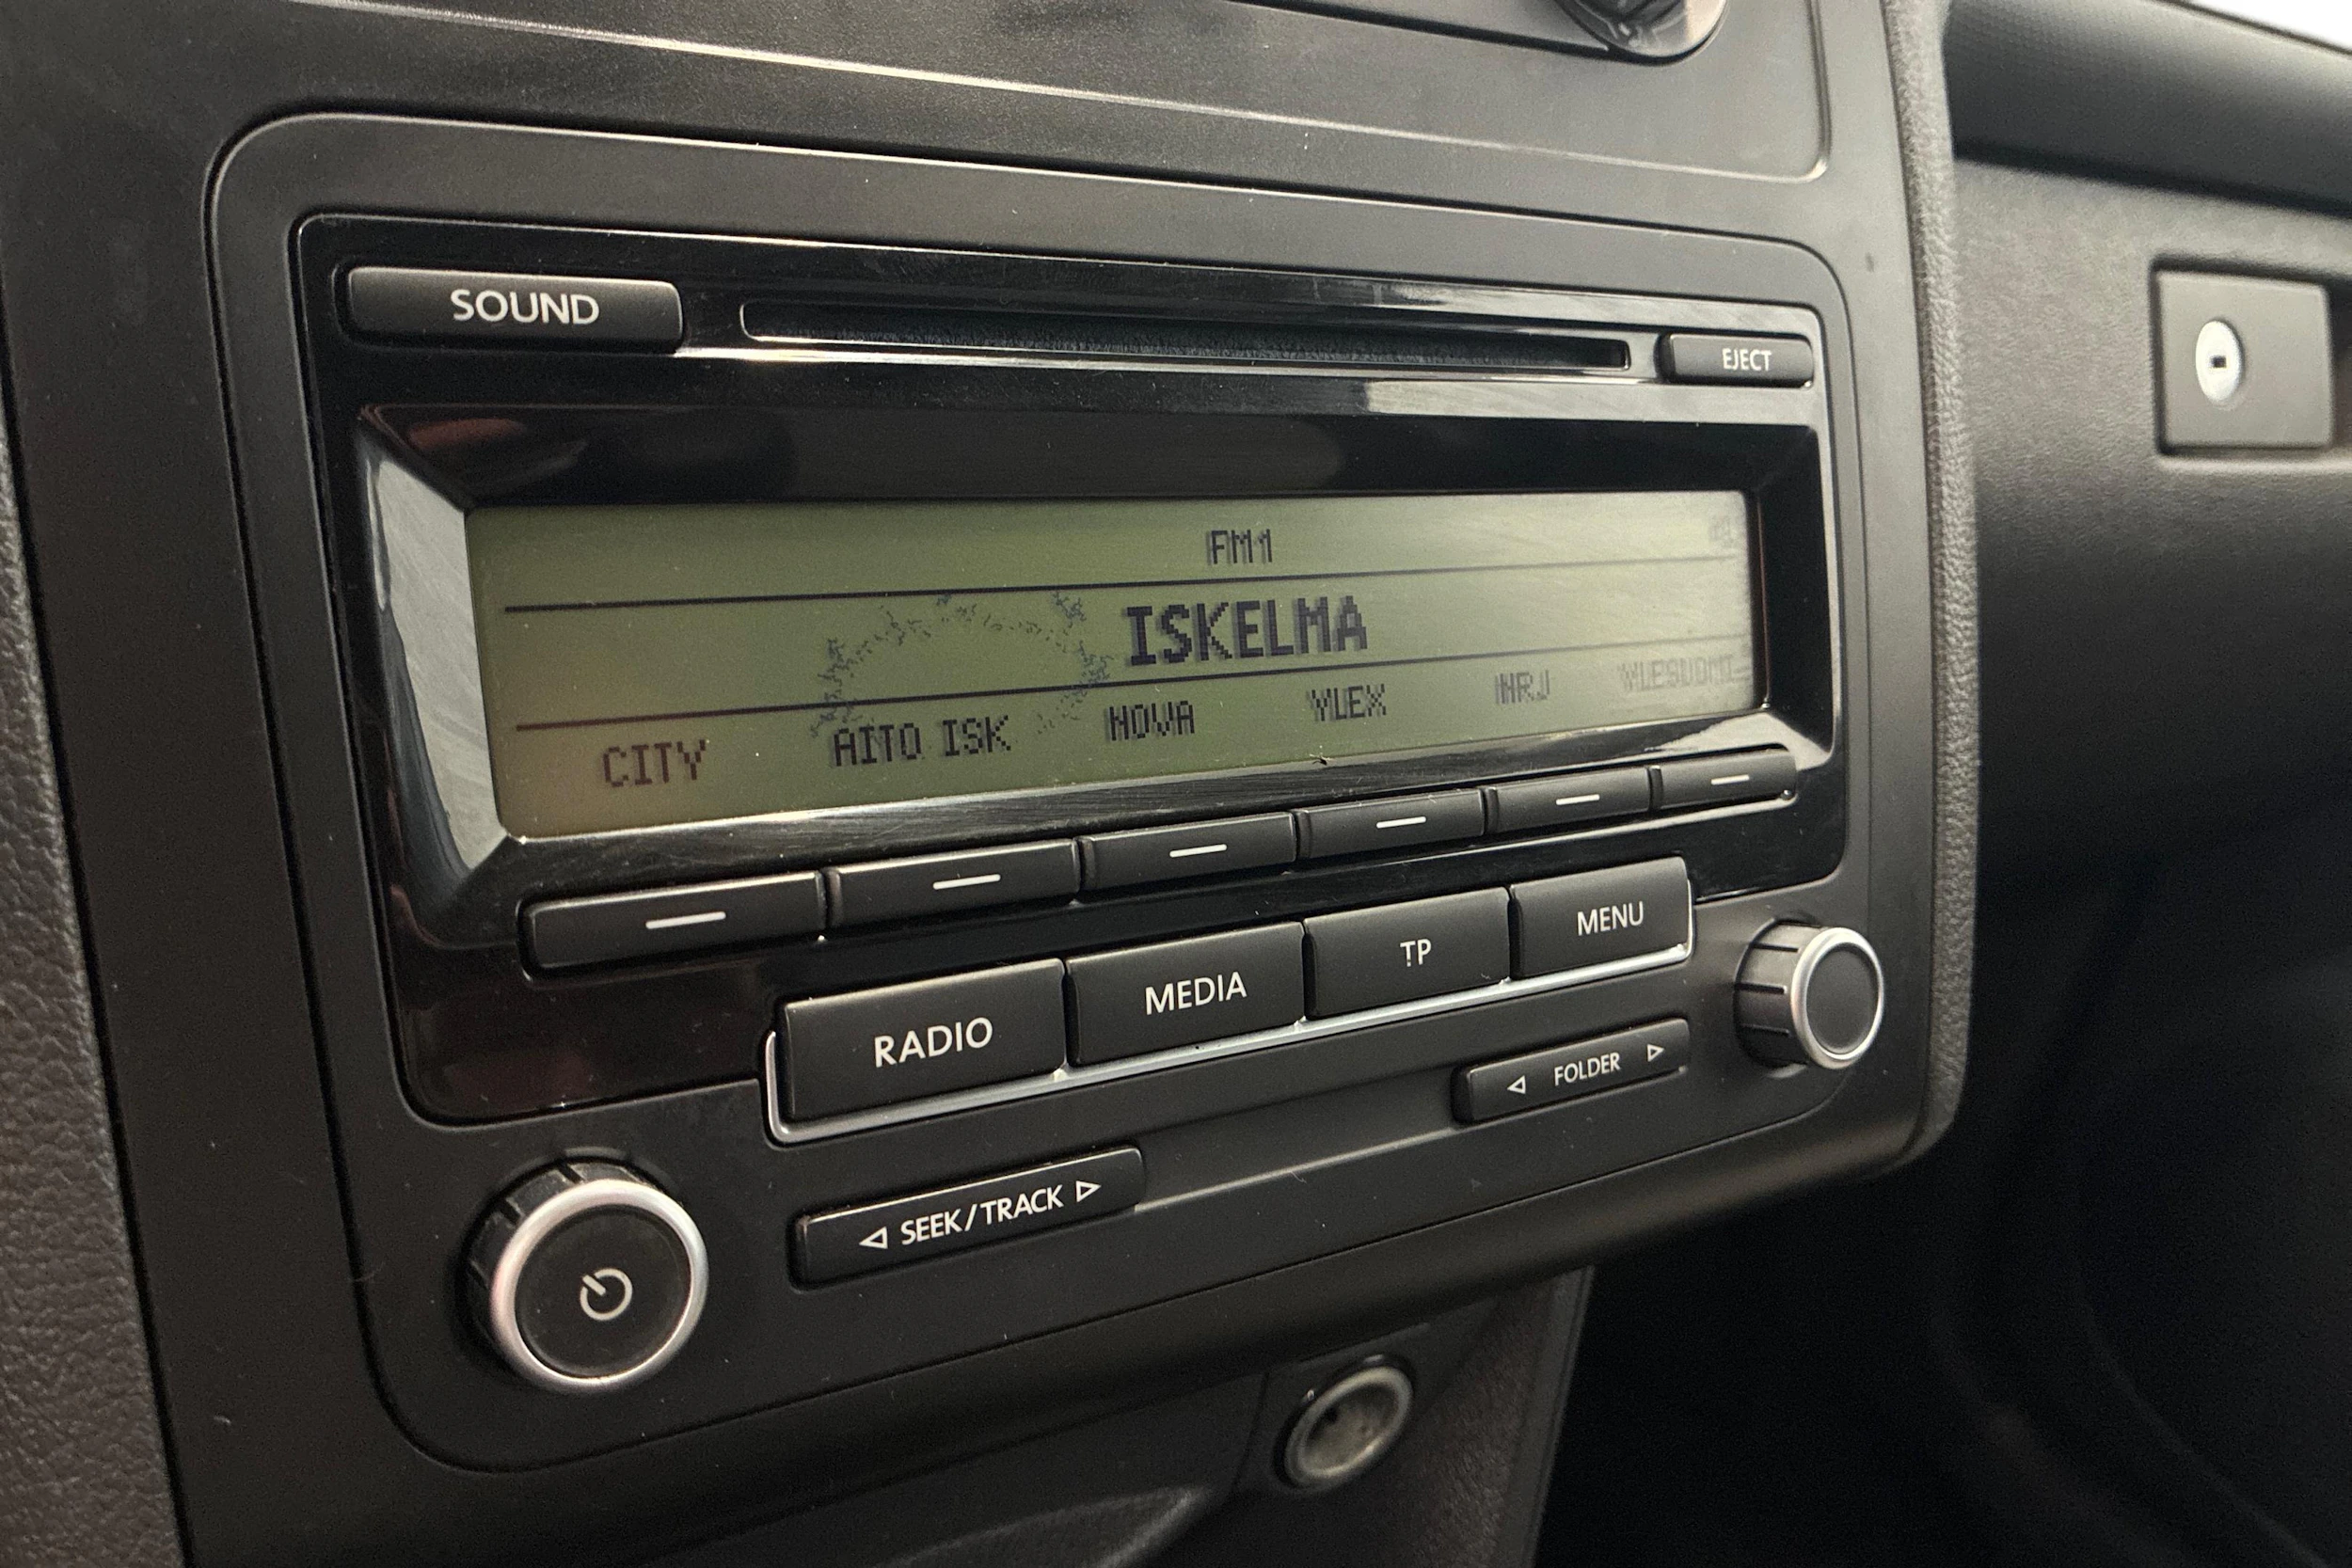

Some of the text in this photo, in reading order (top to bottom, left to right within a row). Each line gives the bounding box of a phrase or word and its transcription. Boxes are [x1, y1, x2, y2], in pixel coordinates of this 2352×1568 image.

[451, 289, 599, 325] SOUND
[1722, 348, 1772, 371] EJECT
[1126, 594, 1368, 666] ISKELMA
[1108, 699, 1196, 741] NOVA
[1311, 683, 1388, 722] YLEX
[832, 714, 1012, 768] AITO ISK
[602, 738, 707, 787] CITY
[1577, 902, 1645, 936] MENU
[1400, 939, 1432, 967] TP
[1144, 971, 1248, 1016] MEDIA
[873, 1017, 993, 1068] RADIO
[1553, 1052, 1621, 1087] FOLDER
